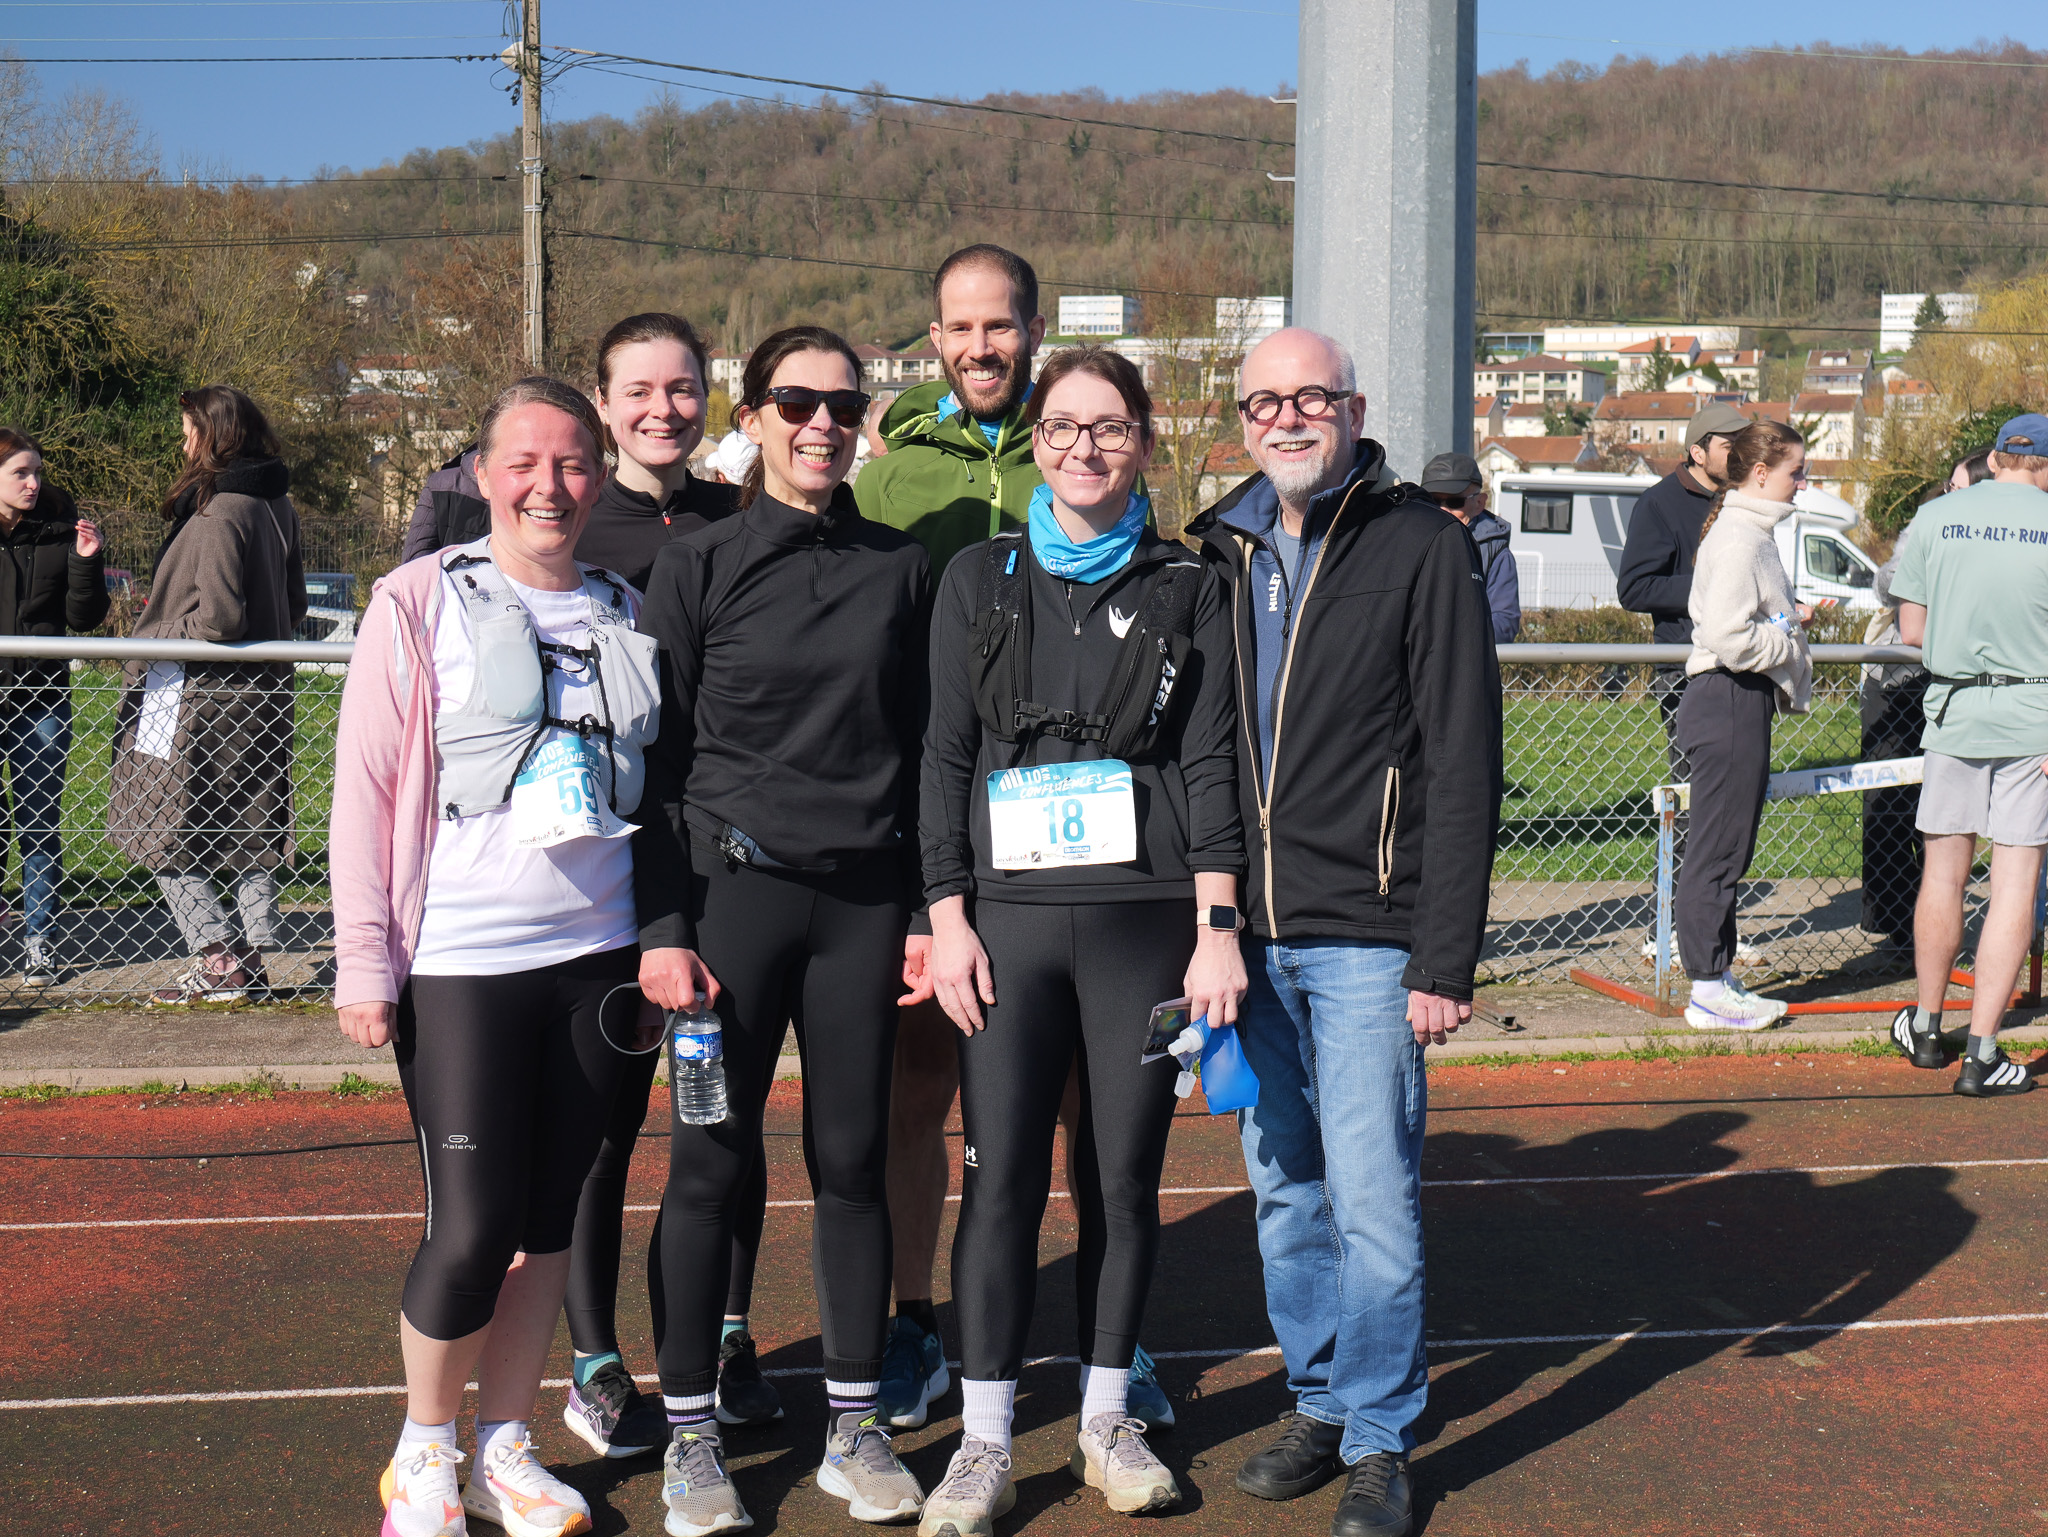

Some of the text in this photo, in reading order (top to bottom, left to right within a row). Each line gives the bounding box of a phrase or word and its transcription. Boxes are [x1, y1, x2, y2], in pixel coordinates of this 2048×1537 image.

[1942, 524, 2048, 545] CTRL + ALT + RUN
[1268, 572, 1281, 612] MILLET
[1148, 659, 1176, 726] AZELA
[1024, 769, 1041, 785] 10
[1043, 798, 1085, 844] 18
[442, 1143, 477, 1151] Kalenji
